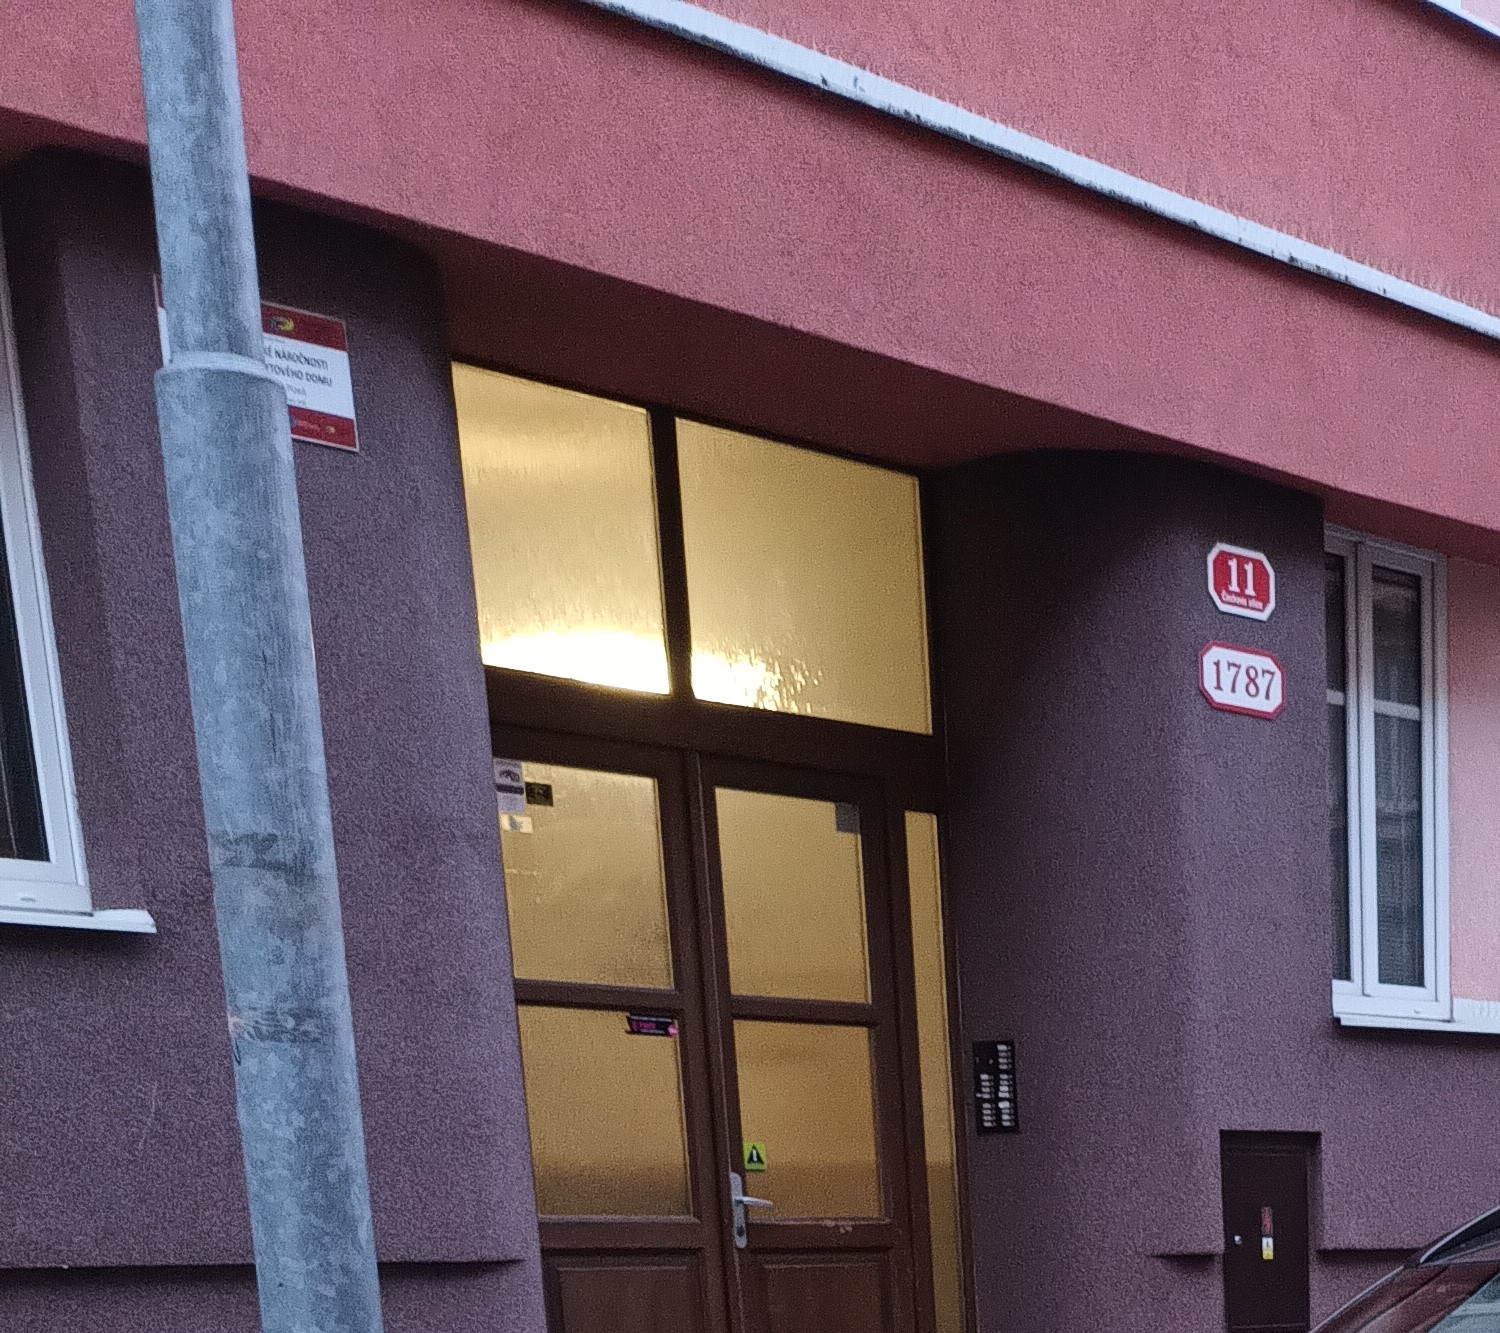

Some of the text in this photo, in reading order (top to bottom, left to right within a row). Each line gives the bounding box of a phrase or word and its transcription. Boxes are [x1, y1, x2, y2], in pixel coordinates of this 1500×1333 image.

[264, 362, 333, 388] YTOVÉHO DOMU
[1228, 557, 1256, 597] 11
[1213, 659, 1276, 701] 1787
